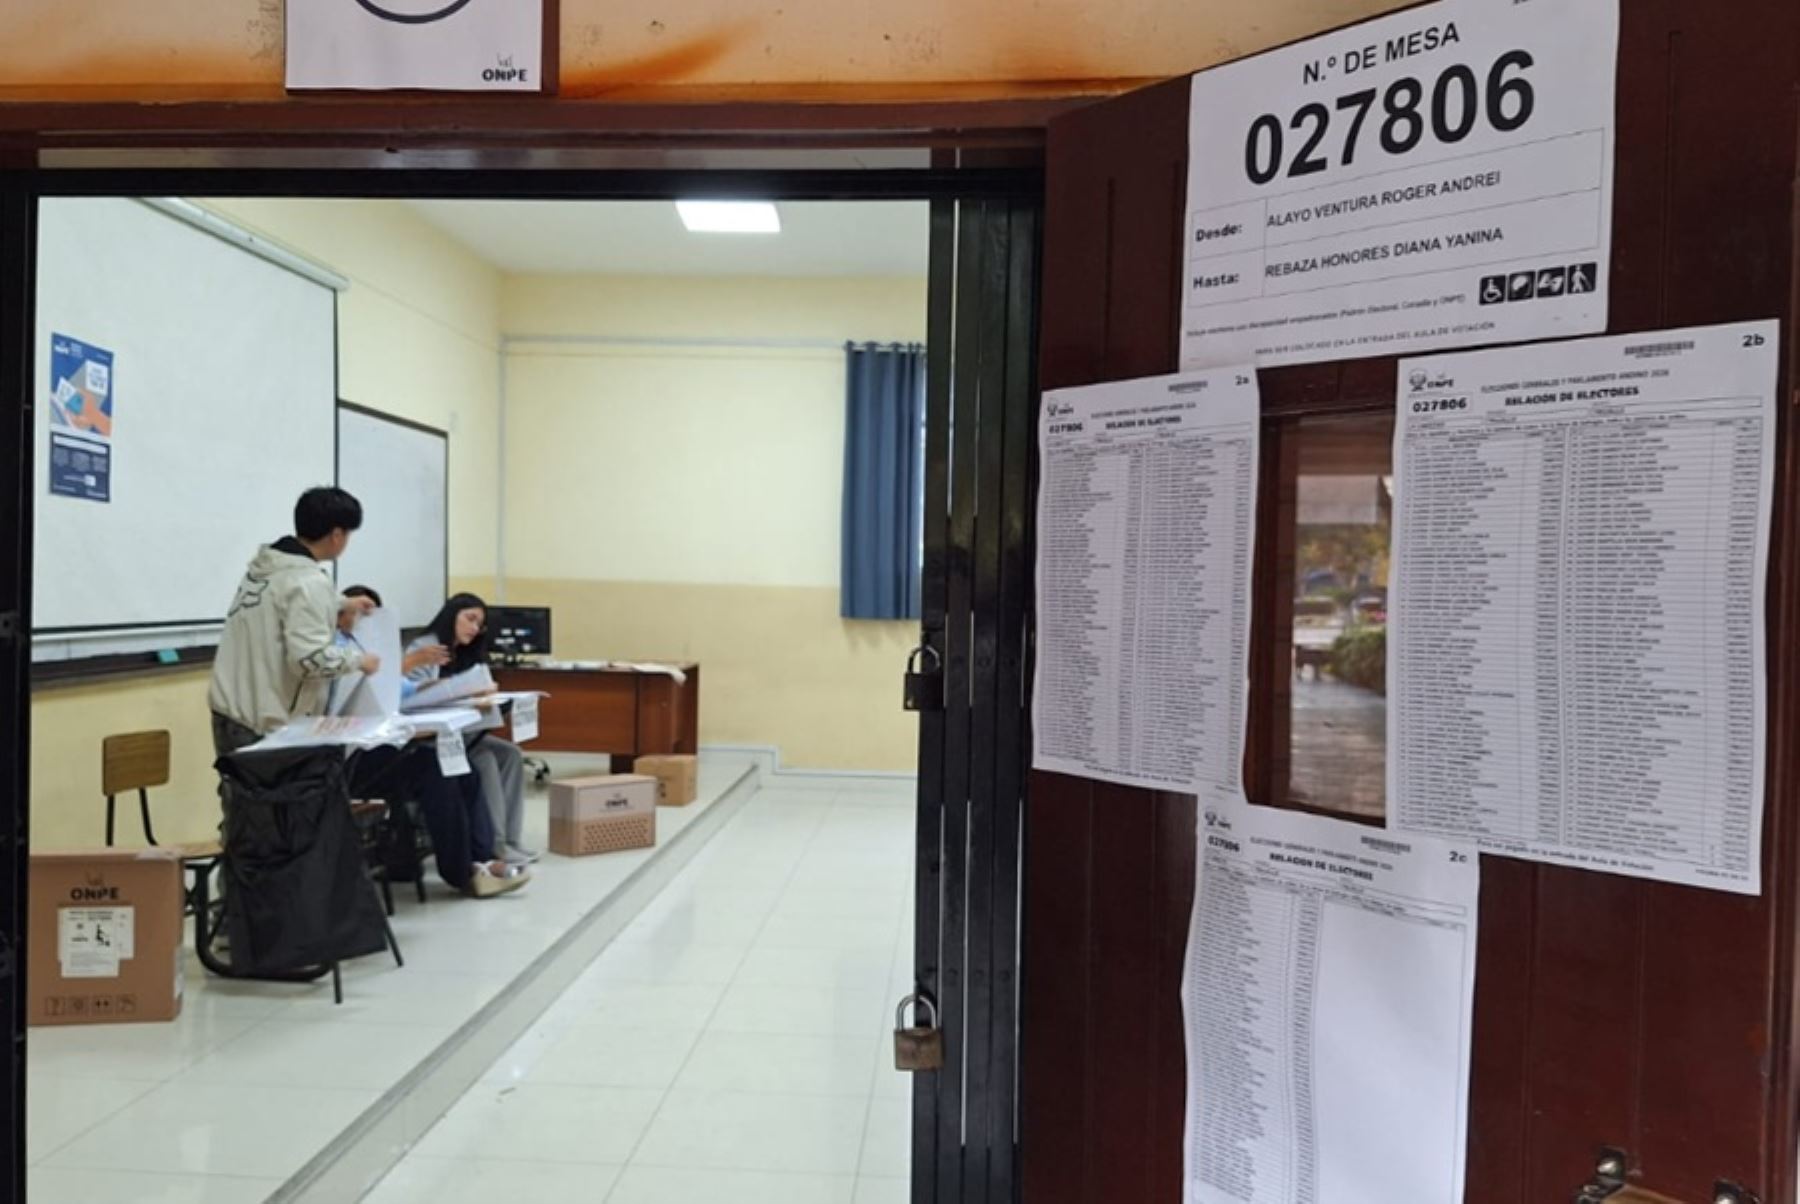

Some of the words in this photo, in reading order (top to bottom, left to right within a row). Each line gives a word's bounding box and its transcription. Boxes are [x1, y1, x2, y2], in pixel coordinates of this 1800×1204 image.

[1303, 56, 1337, 85] N.º
[1345, 46, 1377, 74] DE
[1386, 22, 1460, 62] MESA
[481, 68, 528, 82] ONPE
[1245, 49, 1535, 185] 027806
[1267, 206, 1311, 228] ALAYO
[1315, 195, 1378, 220] VENTURA
[1382, 183, 1436, 205] ROGER
[1440, 170, 1501, 196] ANDREI
[1195, 221, 1242, 242] Desde:
[1266, 258, 1318, 278] REBAZA
[1321, 245, 1389, 268] HONORES
[1394, 237, 1441, 258] DIANA
[1446, 227, 1503, 248] YANINA
[1194, 272, 1240, 290] Hasta:
[1742, 334, 1765, 348] 2b
[1560, 391, 1573, 402] DE
[1577, 386, 1639, 400] ELECTORES
[1413, 398, 1467, 413] 027806
[1449, 851, 1467, 863] 2c
[70, 887, 119, 901] ONPE
